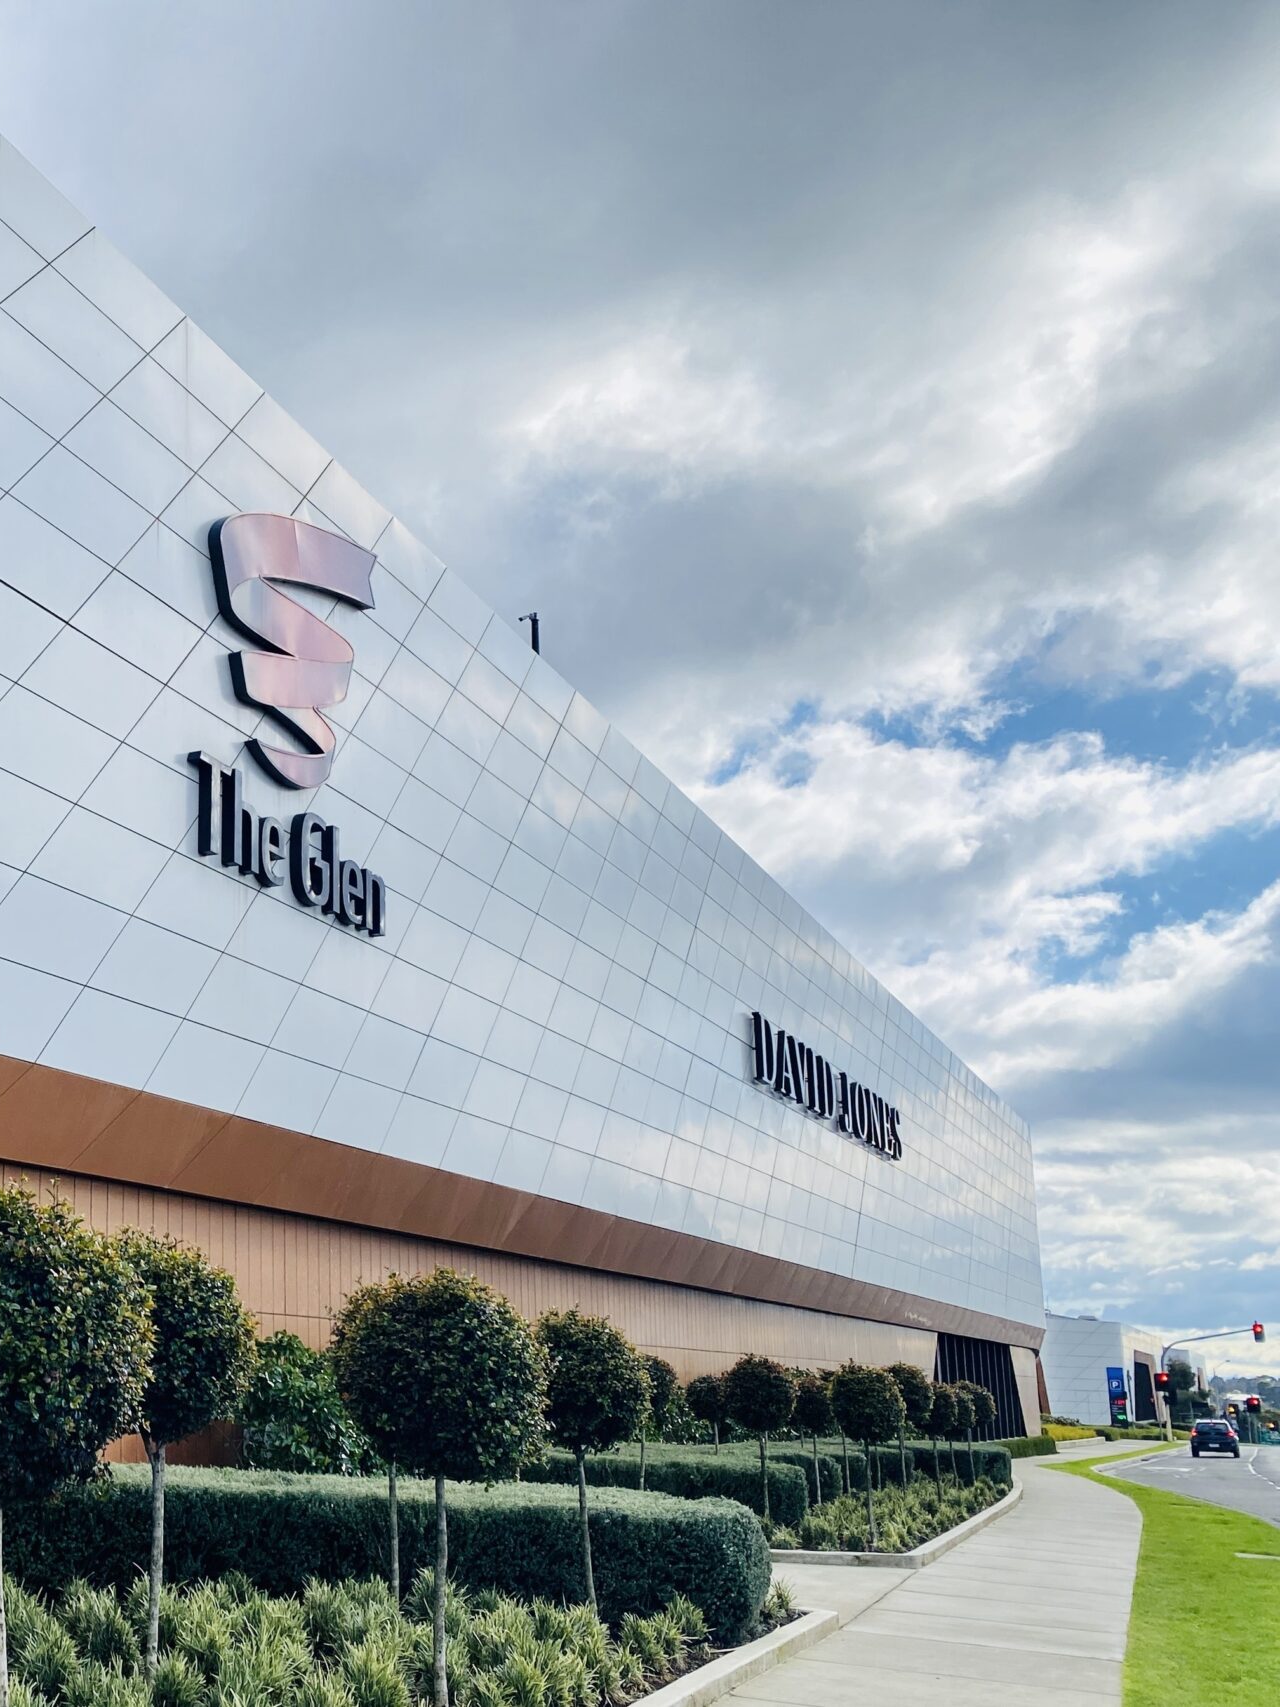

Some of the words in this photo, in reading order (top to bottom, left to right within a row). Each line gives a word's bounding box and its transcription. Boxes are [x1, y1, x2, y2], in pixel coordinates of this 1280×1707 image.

[187, 751, 287, 887] The
[289, 812, 386, 937] Glen
[752, 1012, 836, 1120] DAVID
[838, 1072, 903, 1161] JONES
